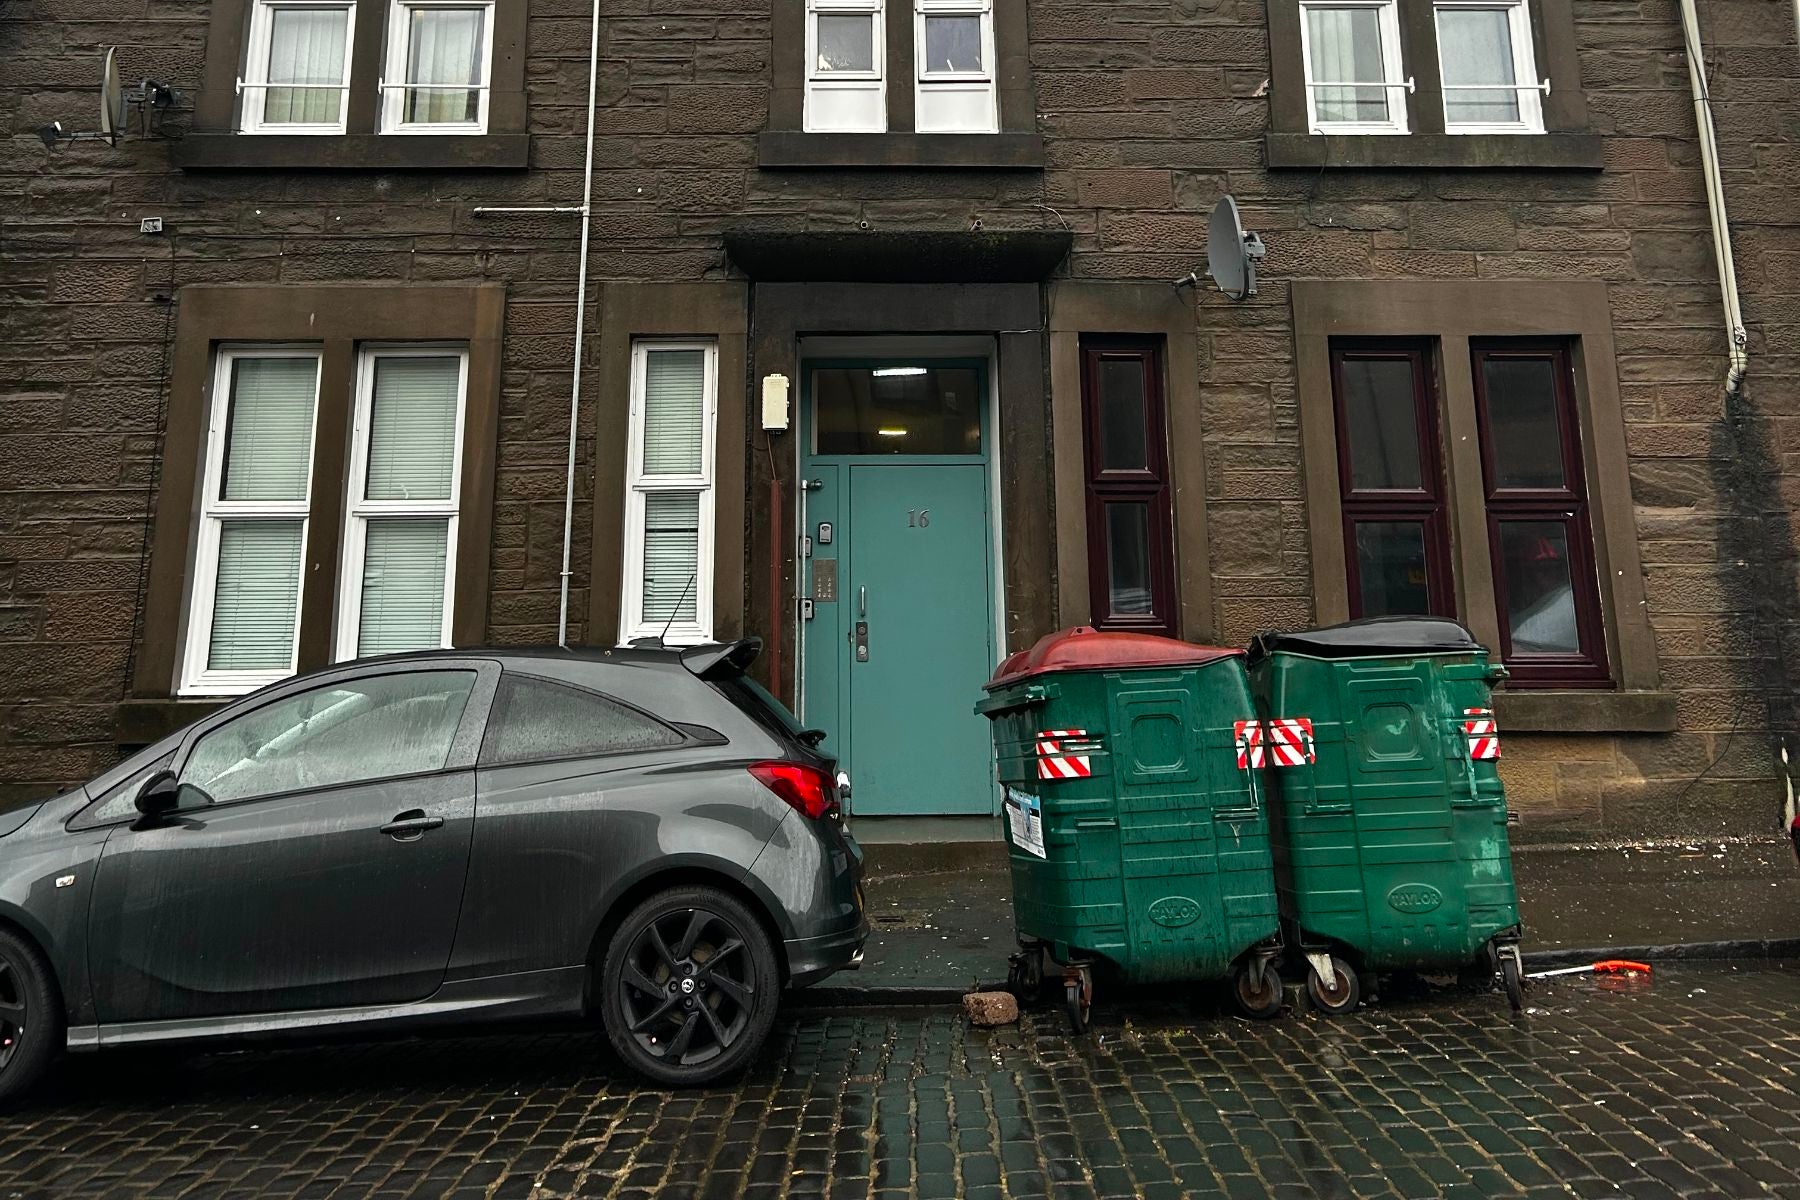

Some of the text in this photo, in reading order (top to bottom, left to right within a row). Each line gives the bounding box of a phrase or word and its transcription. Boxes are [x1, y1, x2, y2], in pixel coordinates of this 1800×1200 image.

[907, 508, 930, 528] 16
[1391, 892, 1439, 906] TAYLOR
[1151, 905, 1198, 920] TAYLOR
